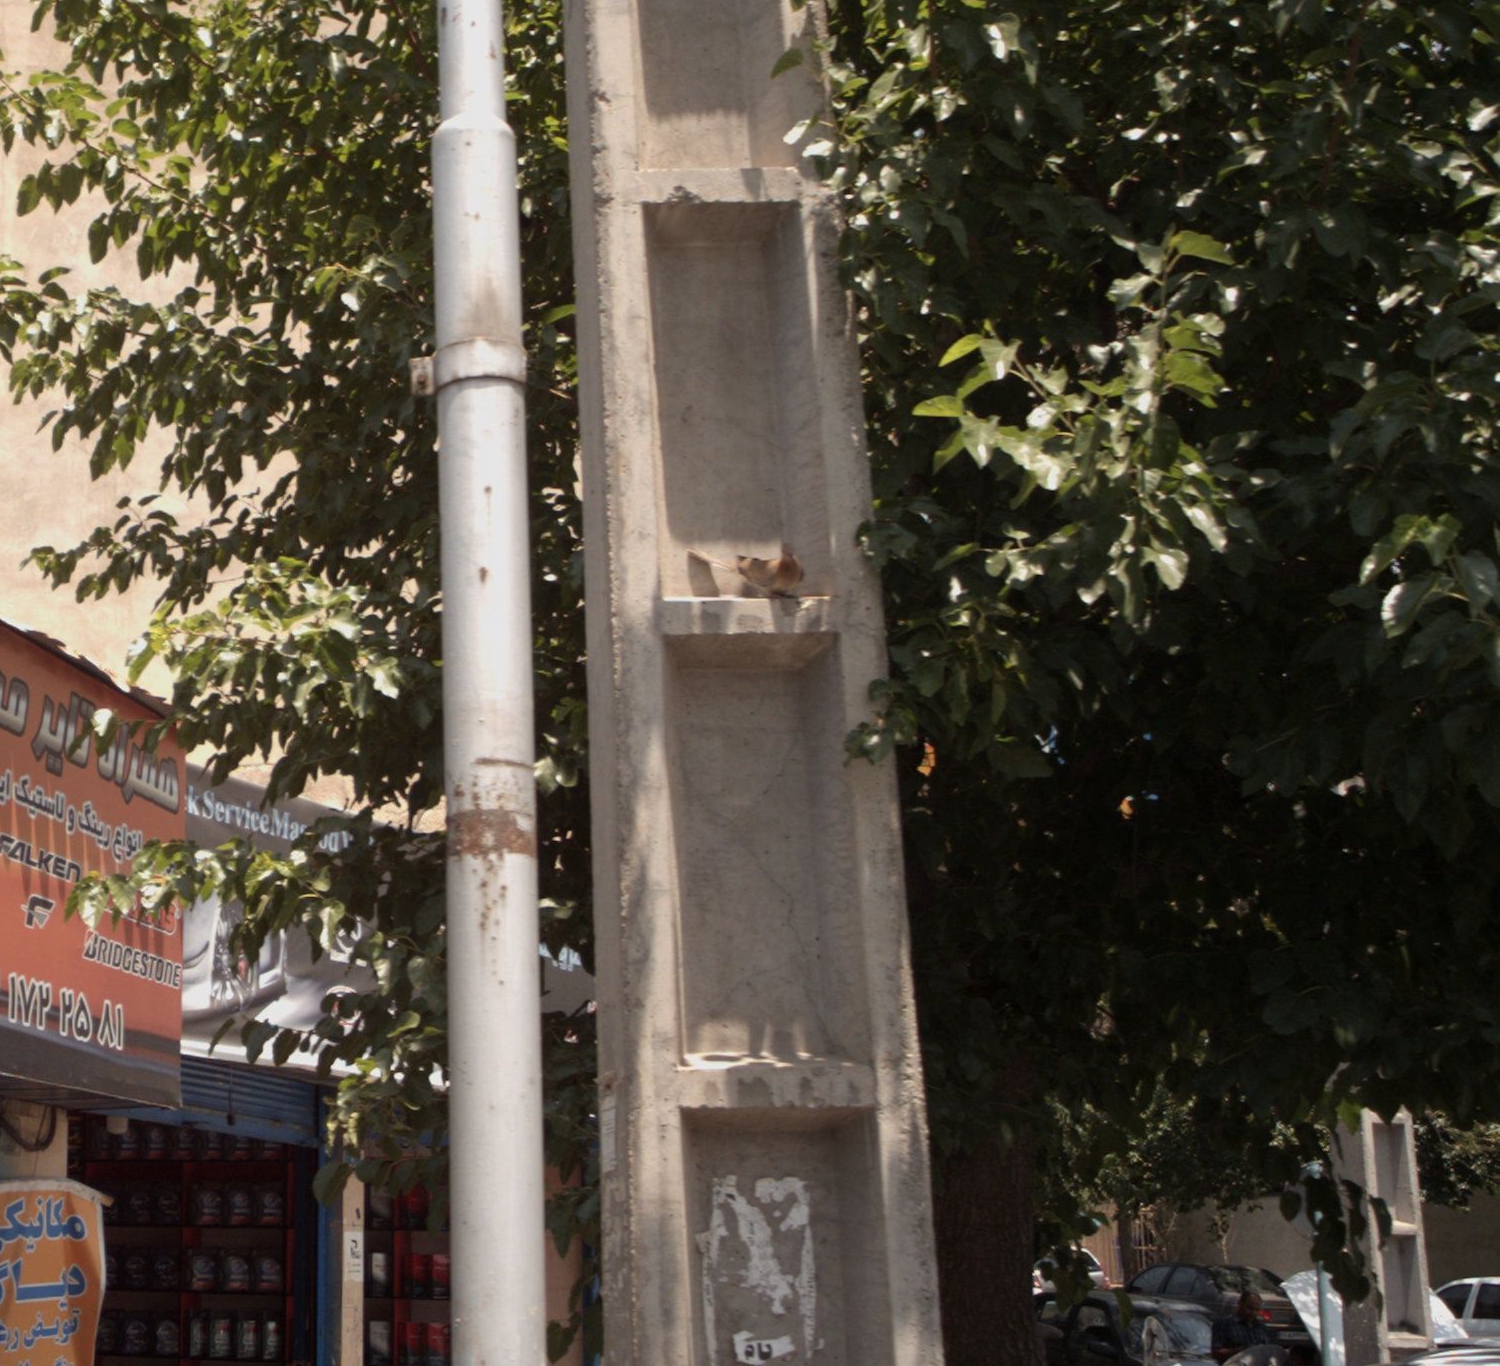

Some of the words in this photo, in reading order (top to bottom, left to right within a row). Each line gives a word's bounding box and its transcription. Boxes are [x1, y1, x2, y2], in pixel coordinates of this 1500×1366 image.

[31, 691, 98, 777] تایر
[13, 774, 66, 820] لاستیک
[66, 807, 76, 834] و
[202, 790, 269, 834] Service
[78, 800, 112, 848] رینگ
[83, 928, 183, 990] BRIDGESTONE
[8, 969, 52, 1031] ۱۷۲
[59, 987, 94, 1042] ۲۵
[97, 999, 125, 1051] ۸۱
